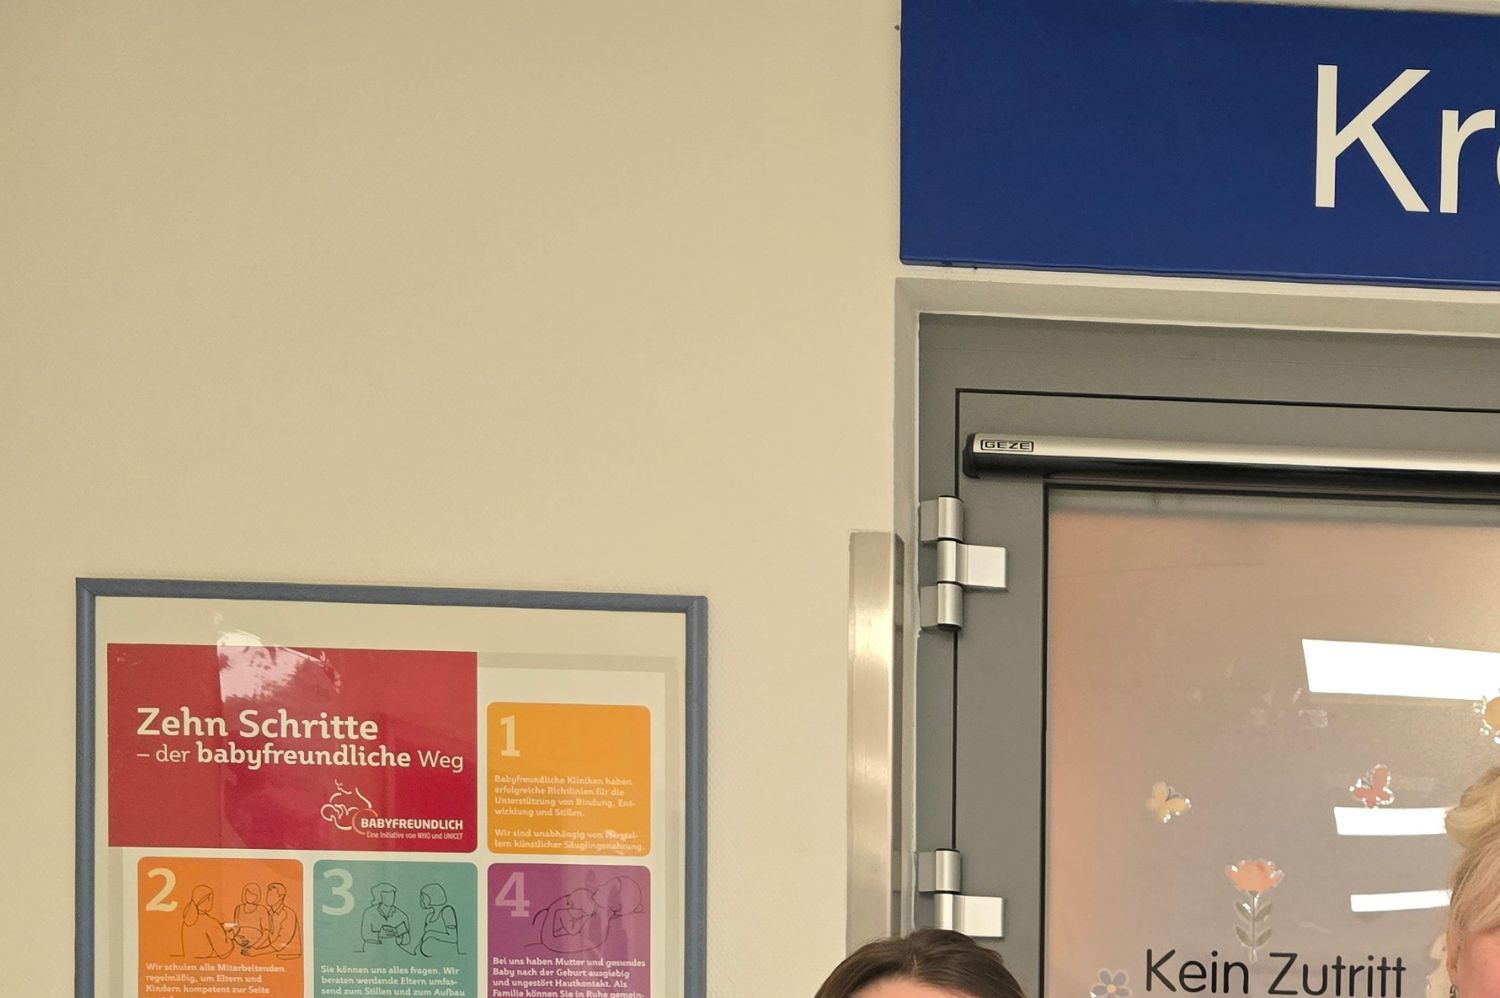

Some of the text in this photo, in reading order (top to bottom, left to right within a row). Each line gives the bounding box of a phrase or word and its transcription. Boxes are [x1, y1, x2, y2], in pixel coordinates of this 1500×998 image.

[985, 441, 1030, 450] GEZE
[137, 706, 378, 740] Zehn Schritte
[501, 715, 520, 757] 1
[155, 744, 190, 763] der
[197, 741, 411, 770] babyfreundliche
[418, 750, 464, 773] Weg
[361, 818, 463, 830] BABYFREUNDLICH
[145, 867, 178, 912] 2
[322, 868, 355, 916] 3
[494, 872, 530, 917] 4
[1146, 948, 1407, 998] Kein Zutritt
